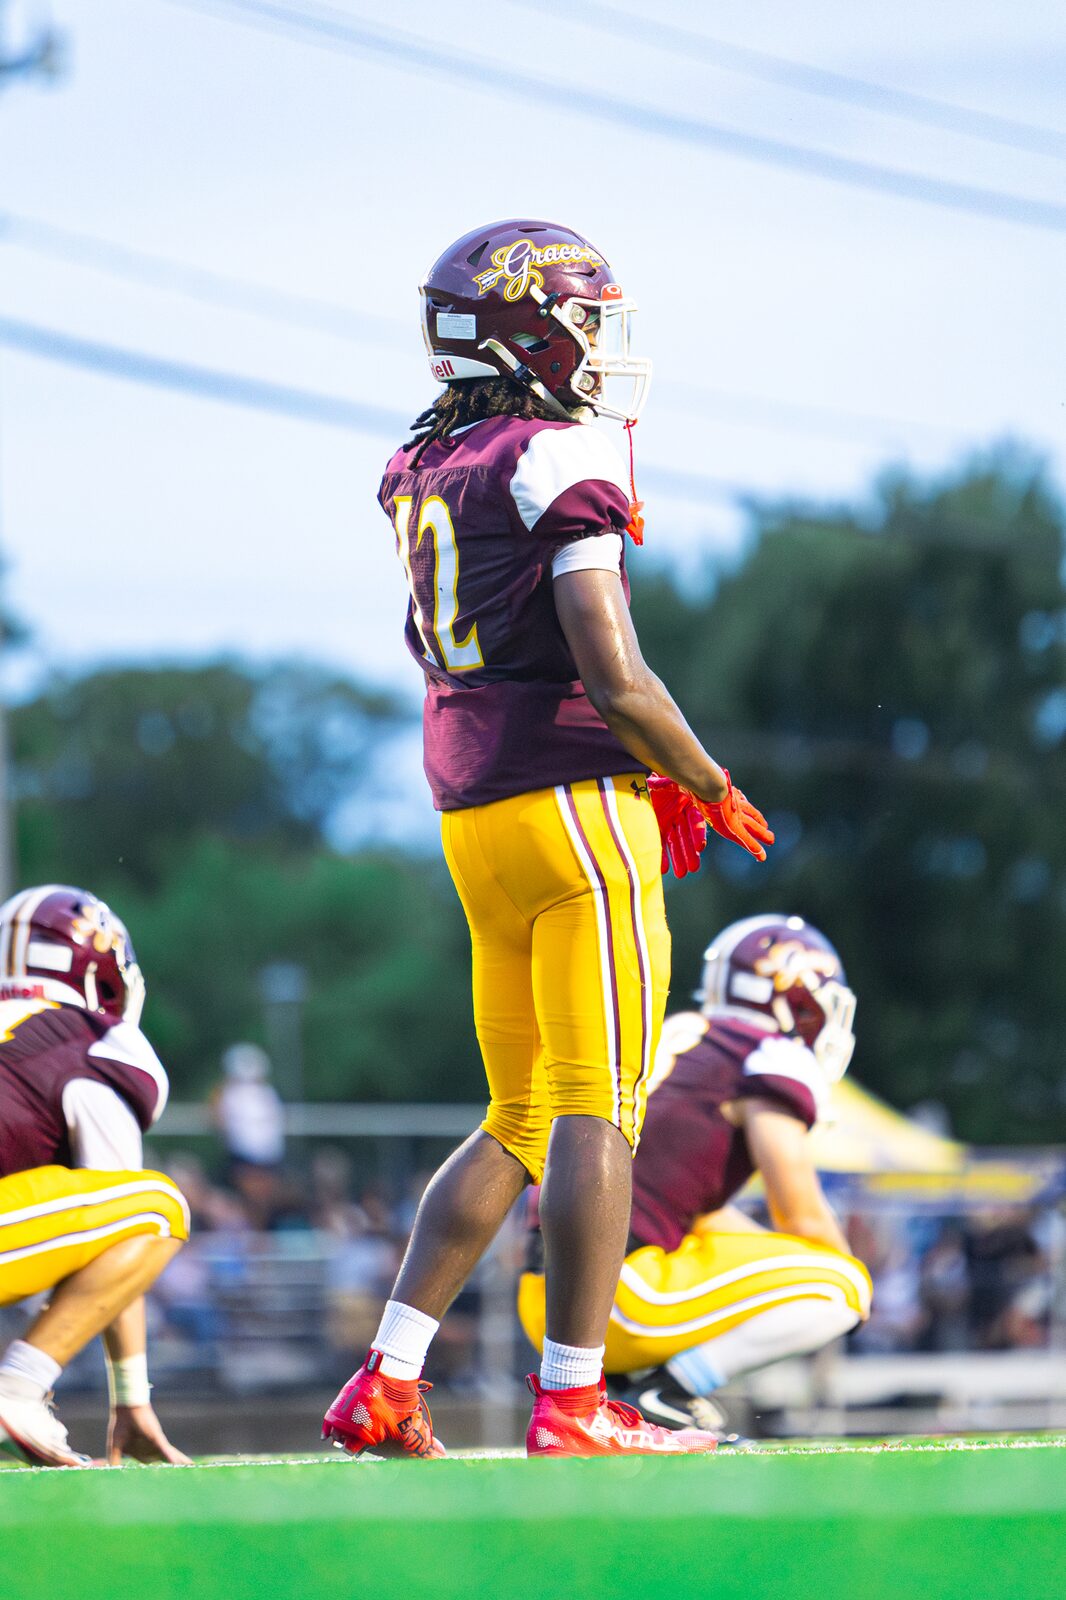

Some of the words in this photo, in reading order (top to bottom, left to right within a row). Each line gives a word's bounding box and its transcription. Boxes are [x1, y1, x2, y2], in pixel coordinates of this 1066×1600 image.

[492, 239, 584, 302] Grace
[393, 495, 485, 673] 12
[588, 1410, 689, 1452] BATTLE
